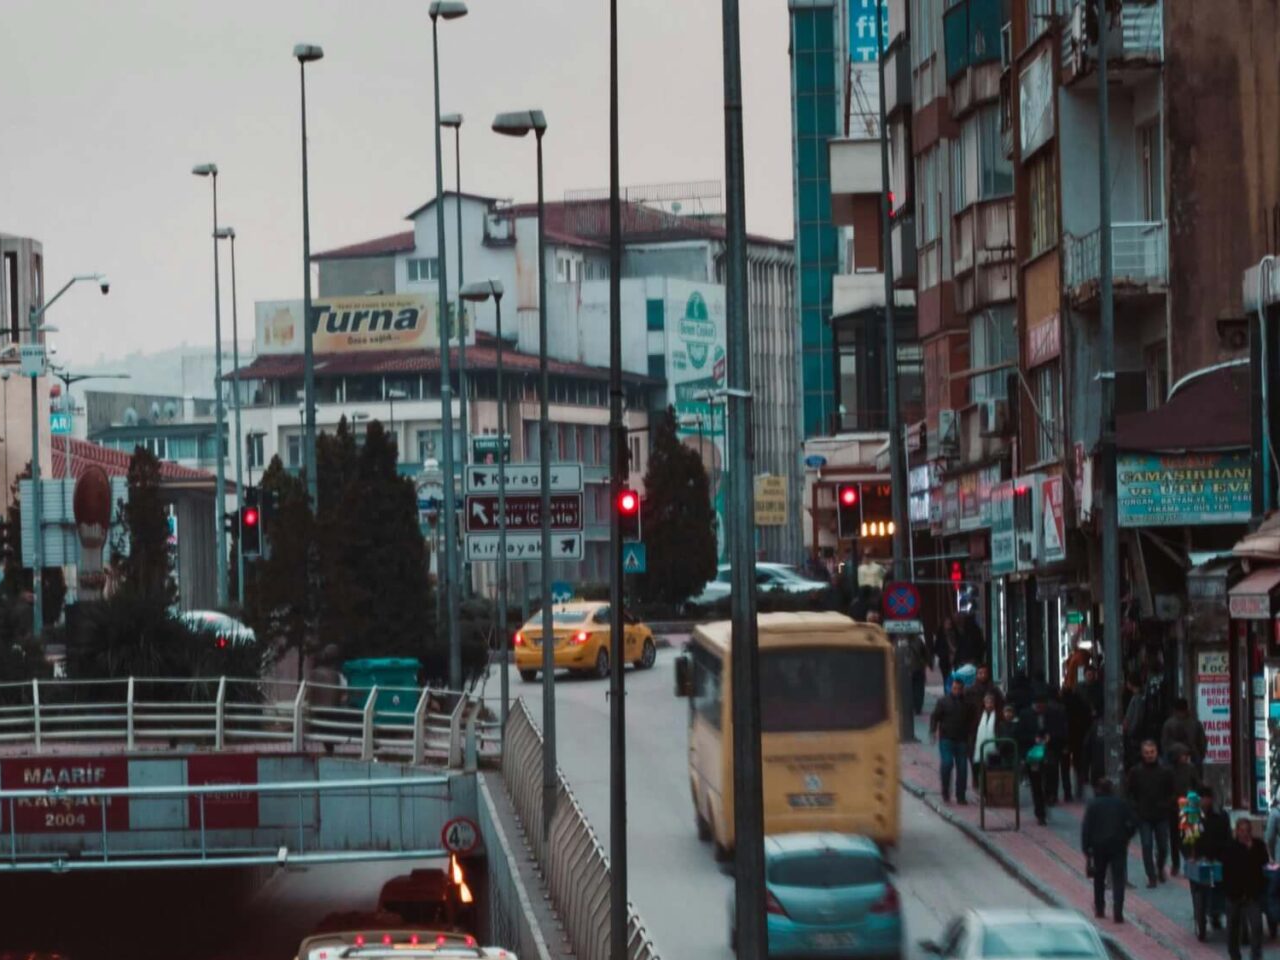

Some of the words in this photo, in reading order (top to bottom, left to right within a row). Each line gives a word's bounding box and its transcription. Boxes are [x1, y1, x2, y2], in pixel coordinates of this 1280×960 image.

[310, 305, 420, 333] Turna
[492, 473, 559, 485] Karagz
[527, 512, 578, 525] (Cstle)
[24, 763, 106, 784] MAARİF
[45, 814, 86, 828] 2004
